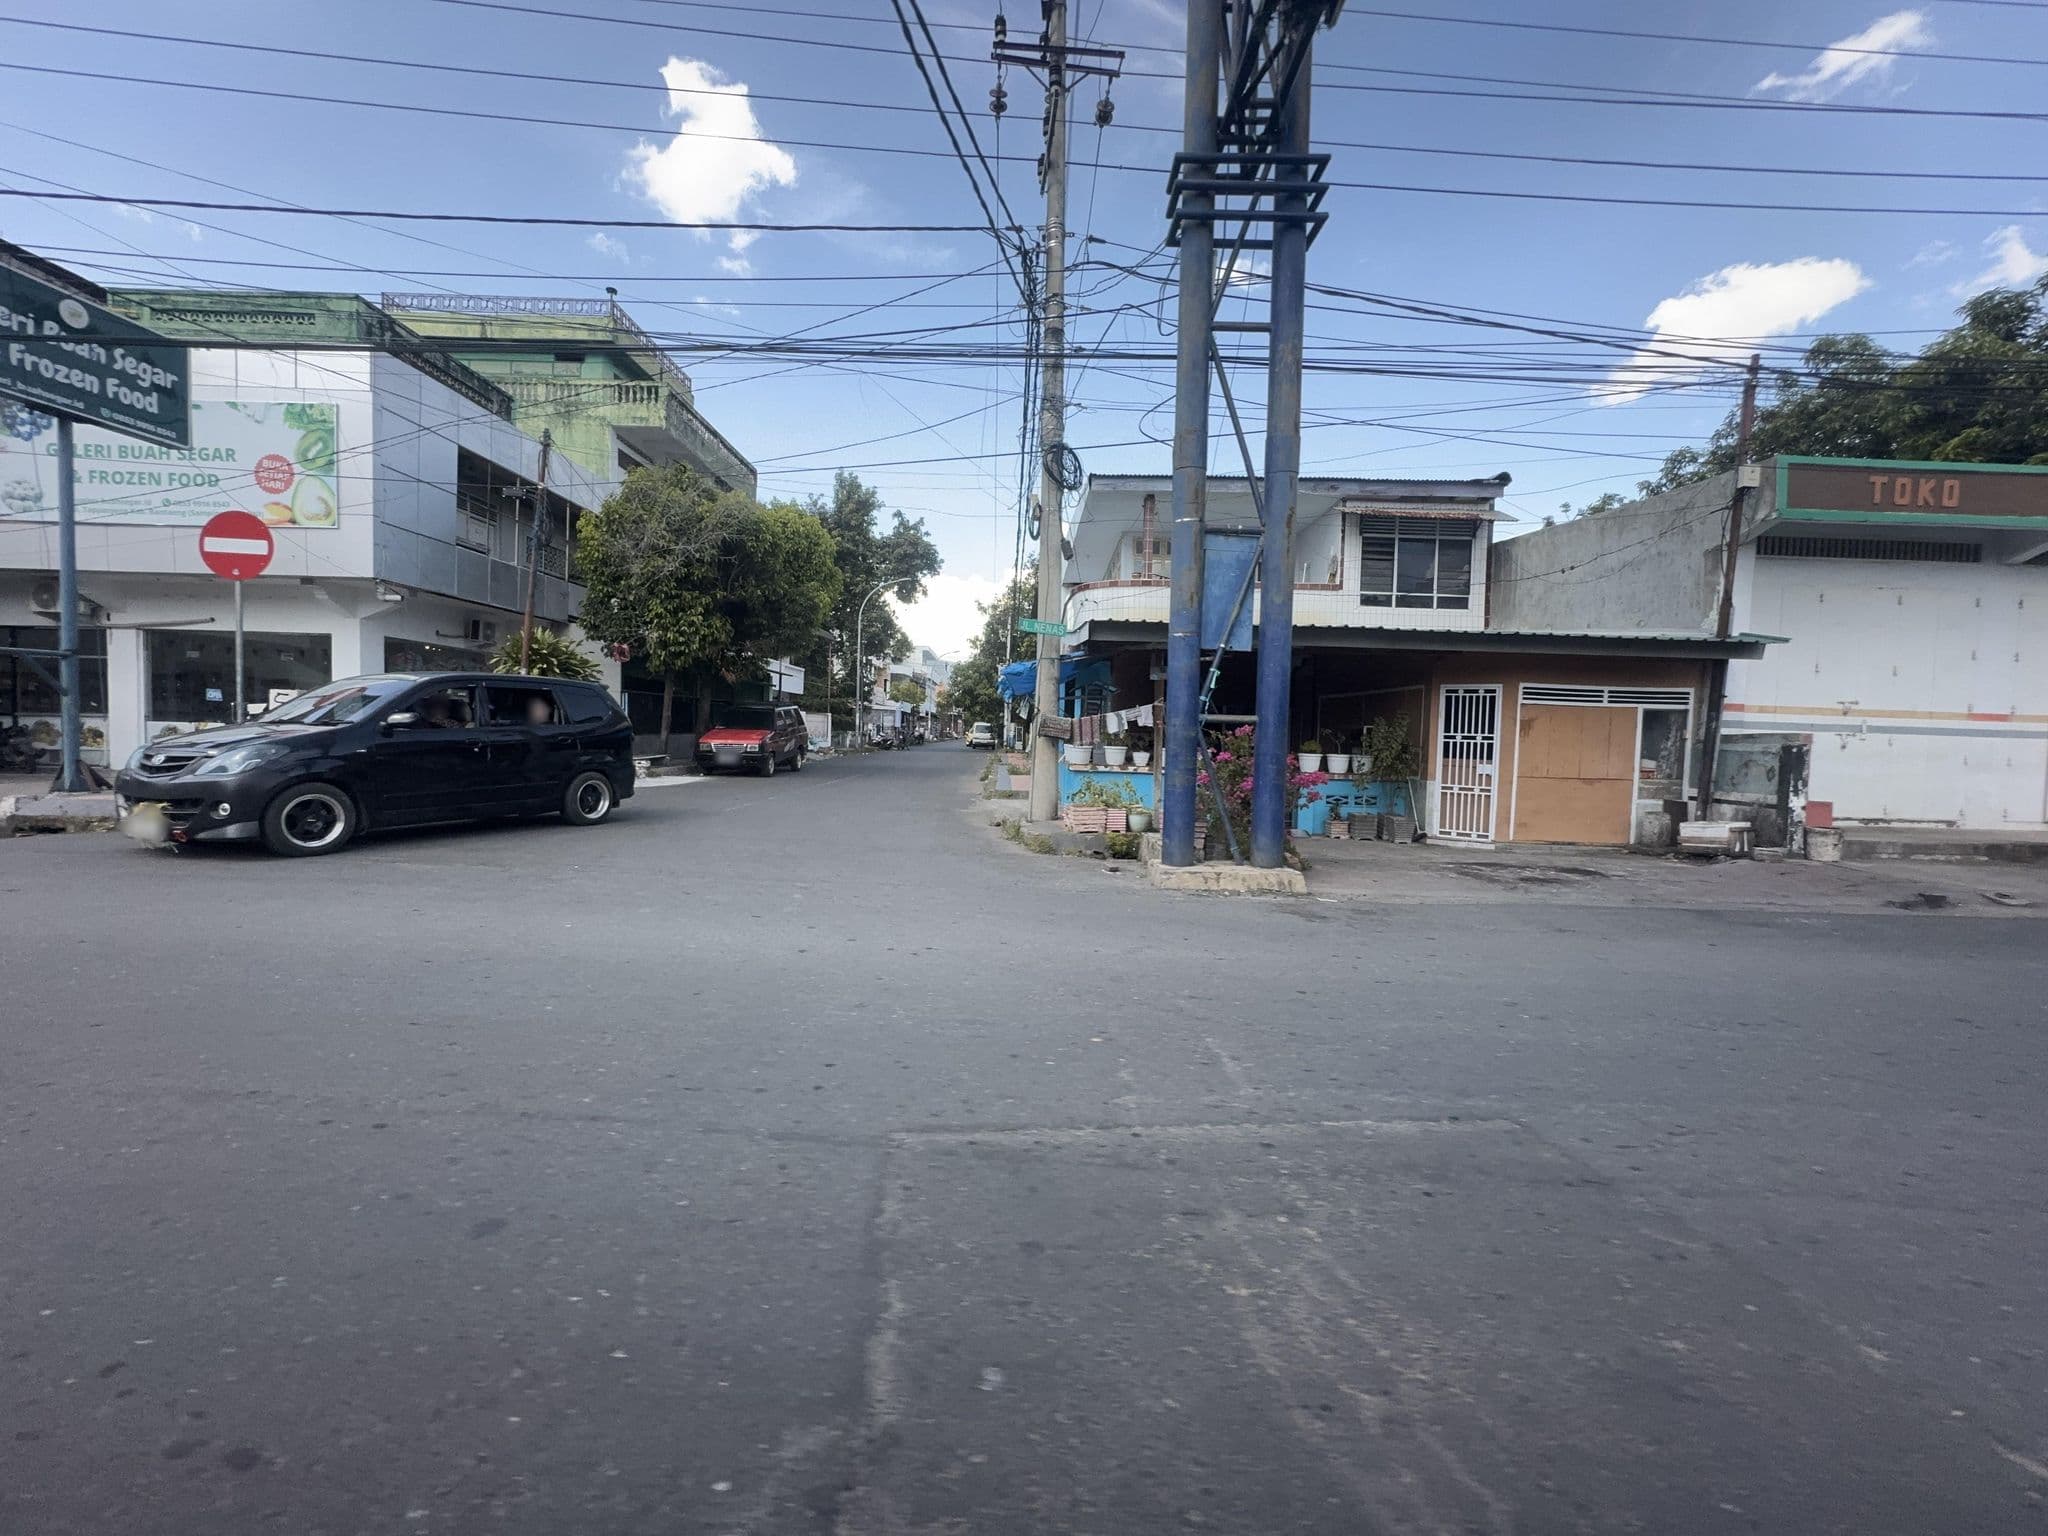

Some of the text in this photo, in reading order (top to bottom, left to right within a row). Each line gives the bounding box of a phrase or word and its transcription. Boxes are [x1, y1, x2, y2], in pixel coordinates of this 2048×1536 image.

[9, 343, 100, 394] Frozen
[105, 377, 159, 414] Food
[112, 347, 179, 389] Segar
[46, 442, 237, 463] GLERI BUAH SEGAR
[88, 469, 162, 487] FROZEN
[168, 472, 220, 489] FOOD
[1869, 475, 1960, 508] TOKO
[1034, 622, 1065, 635] NENAS
